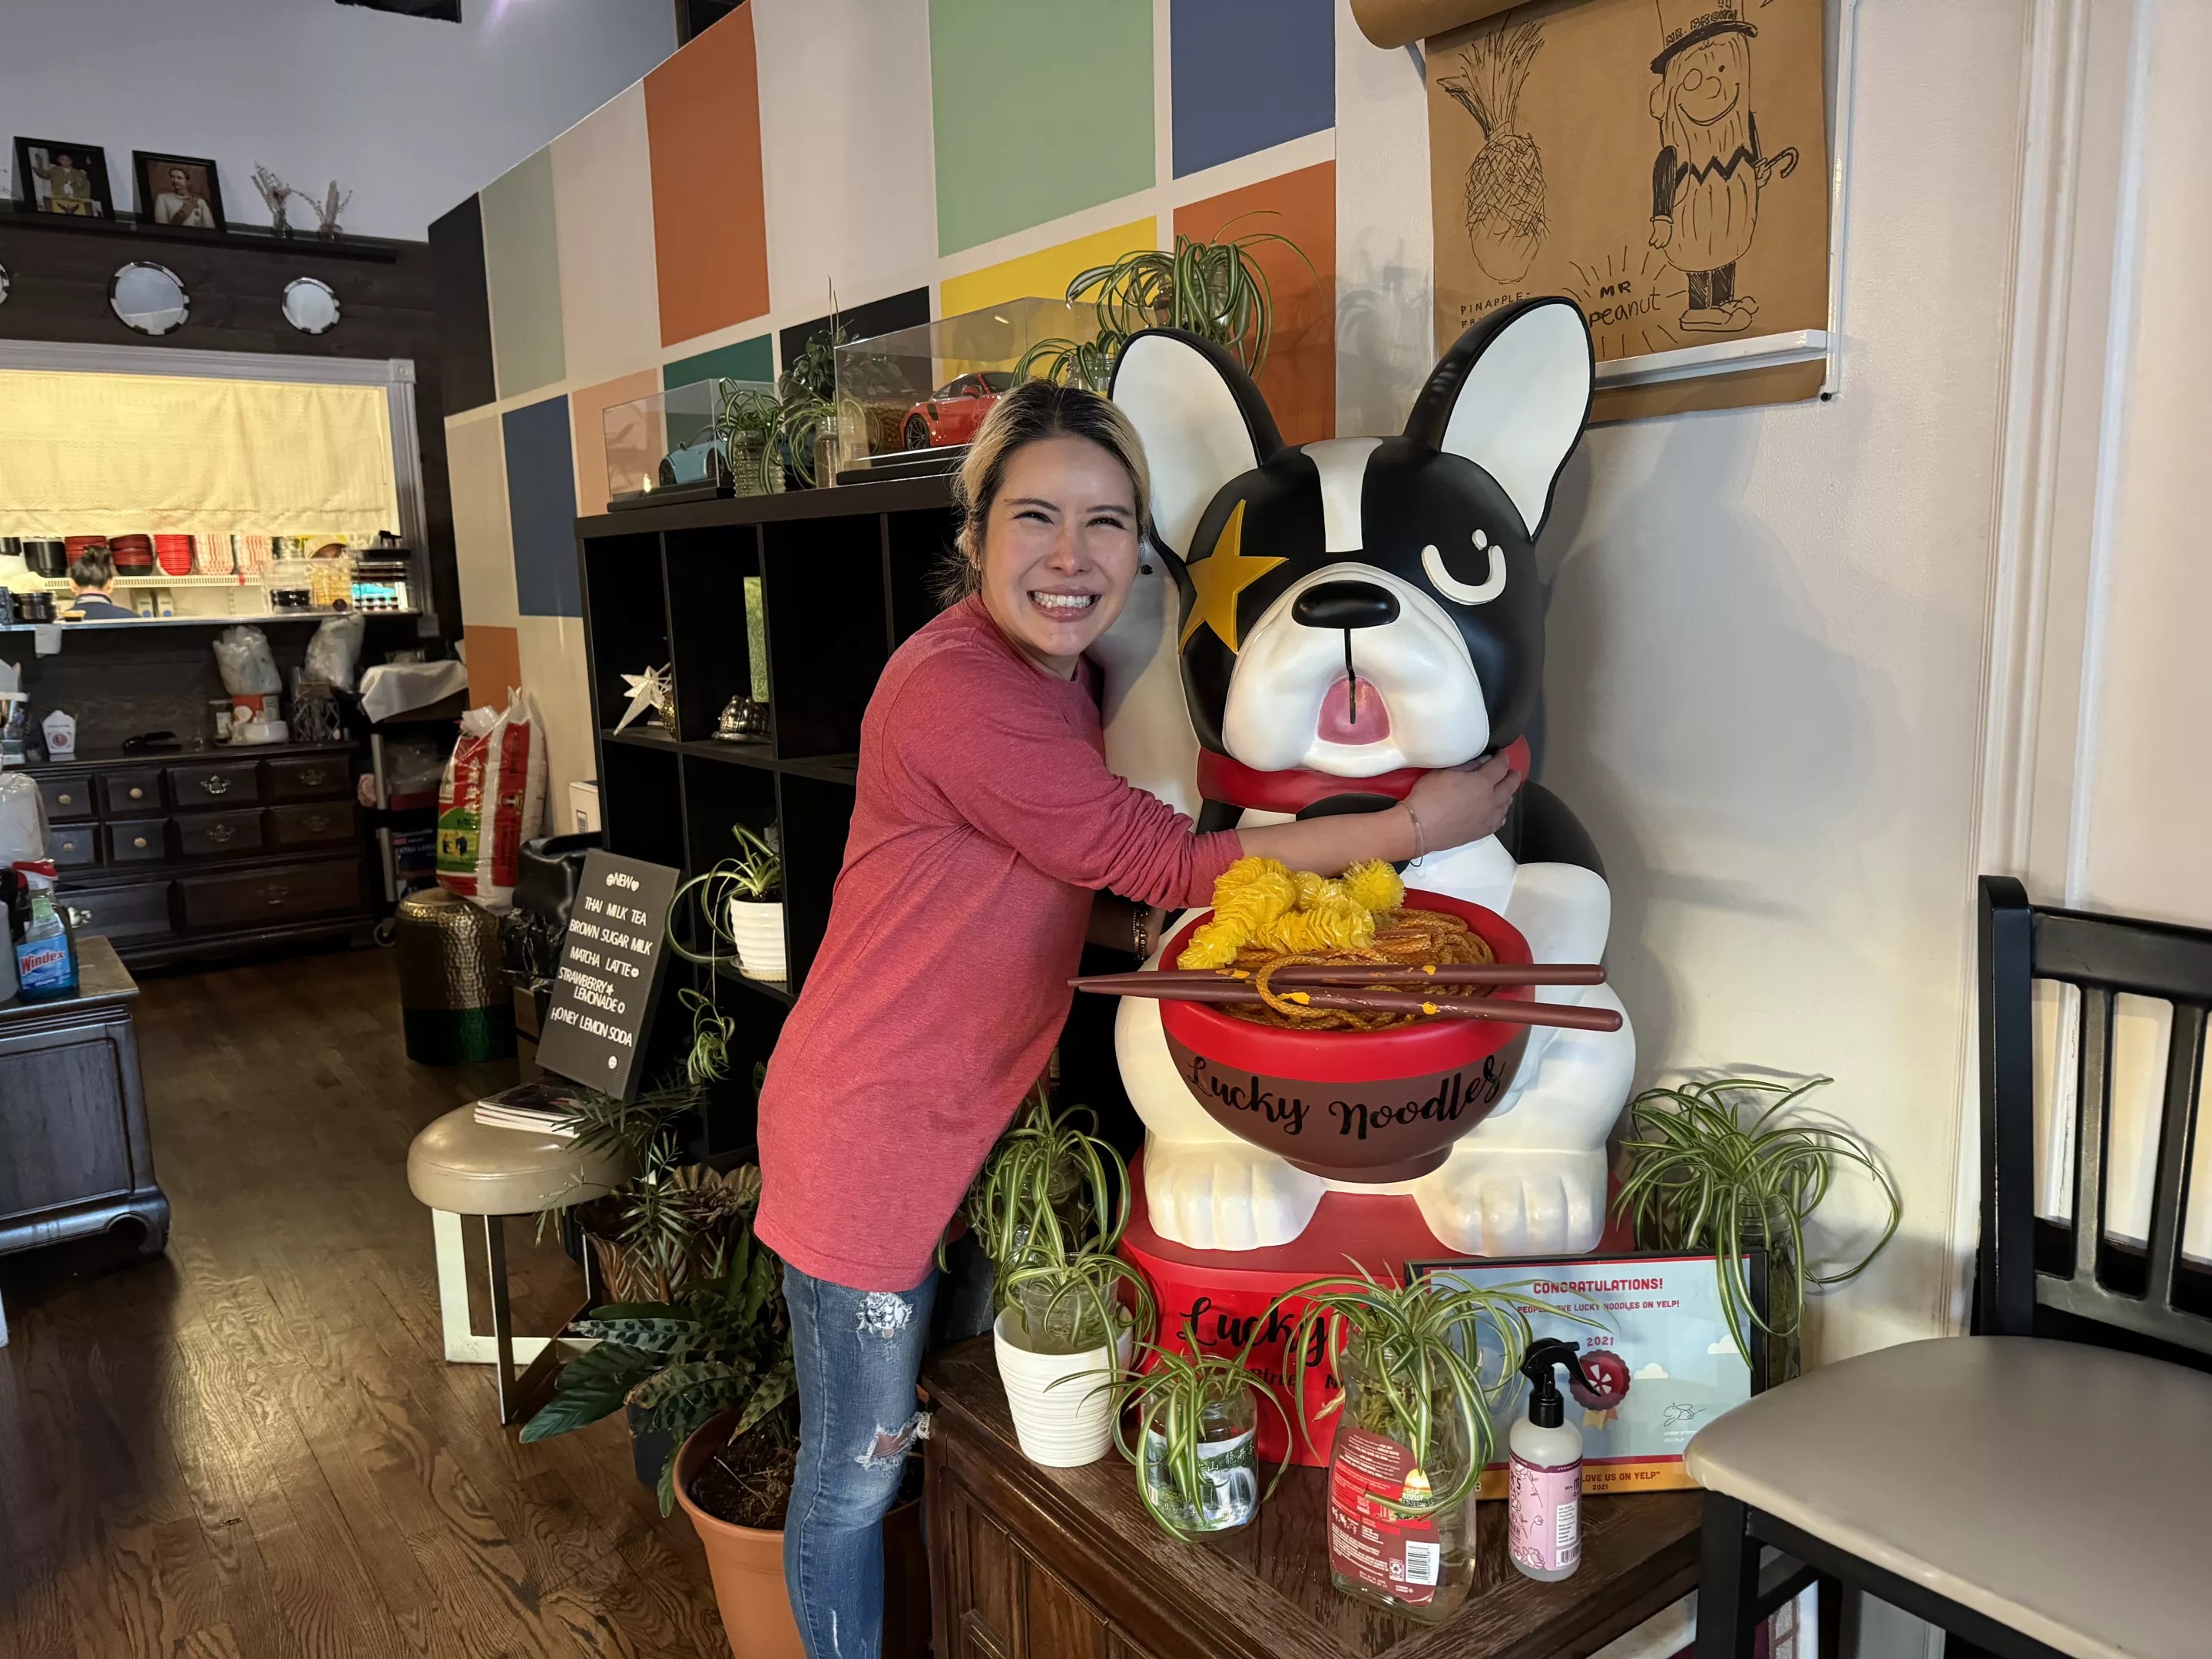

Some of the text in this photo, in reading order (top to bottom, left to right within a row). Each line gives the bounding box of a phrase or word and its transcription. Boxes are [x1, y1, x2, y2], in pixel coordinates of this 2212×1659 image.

[1690, 9, 1737, 30] BROWN
[1600, 281, 1631, 299] MR
[614, 873, 632, 889] NEW
[585, 896, 647, 926] THAI MILK TEA
[569, 919, 653, 955] BROWN SUGAR MILK
[20, 951, 65, 975] Windex
[570, 946, 631, 977] MATCHA LATTE
[558, 966, 607, 992] STRAWBERRY
[573, 985, 618, 1012] LEMONADE
[551, 1007, 632, 1047] HONEY LEMON SODA
[1186, 1055, 1506, 1141] Lucky Noodles
[1533, 1278, 1664, 1294] CONGRATULATIONS!
[1518, 1306, 1548, 1314] PEOPL
[1553, 1304, 1571, 1313] OVE
[1575, 1303, 1600, 1313] LUCKY
[1603, 1302, 1641, 1311] NOODLES
[1656, 1300, 1680, 1309] YELP!
[1177, 1296, 1330, 1367] Lucky
[1587, 1336, 1614, 1346] 2021
